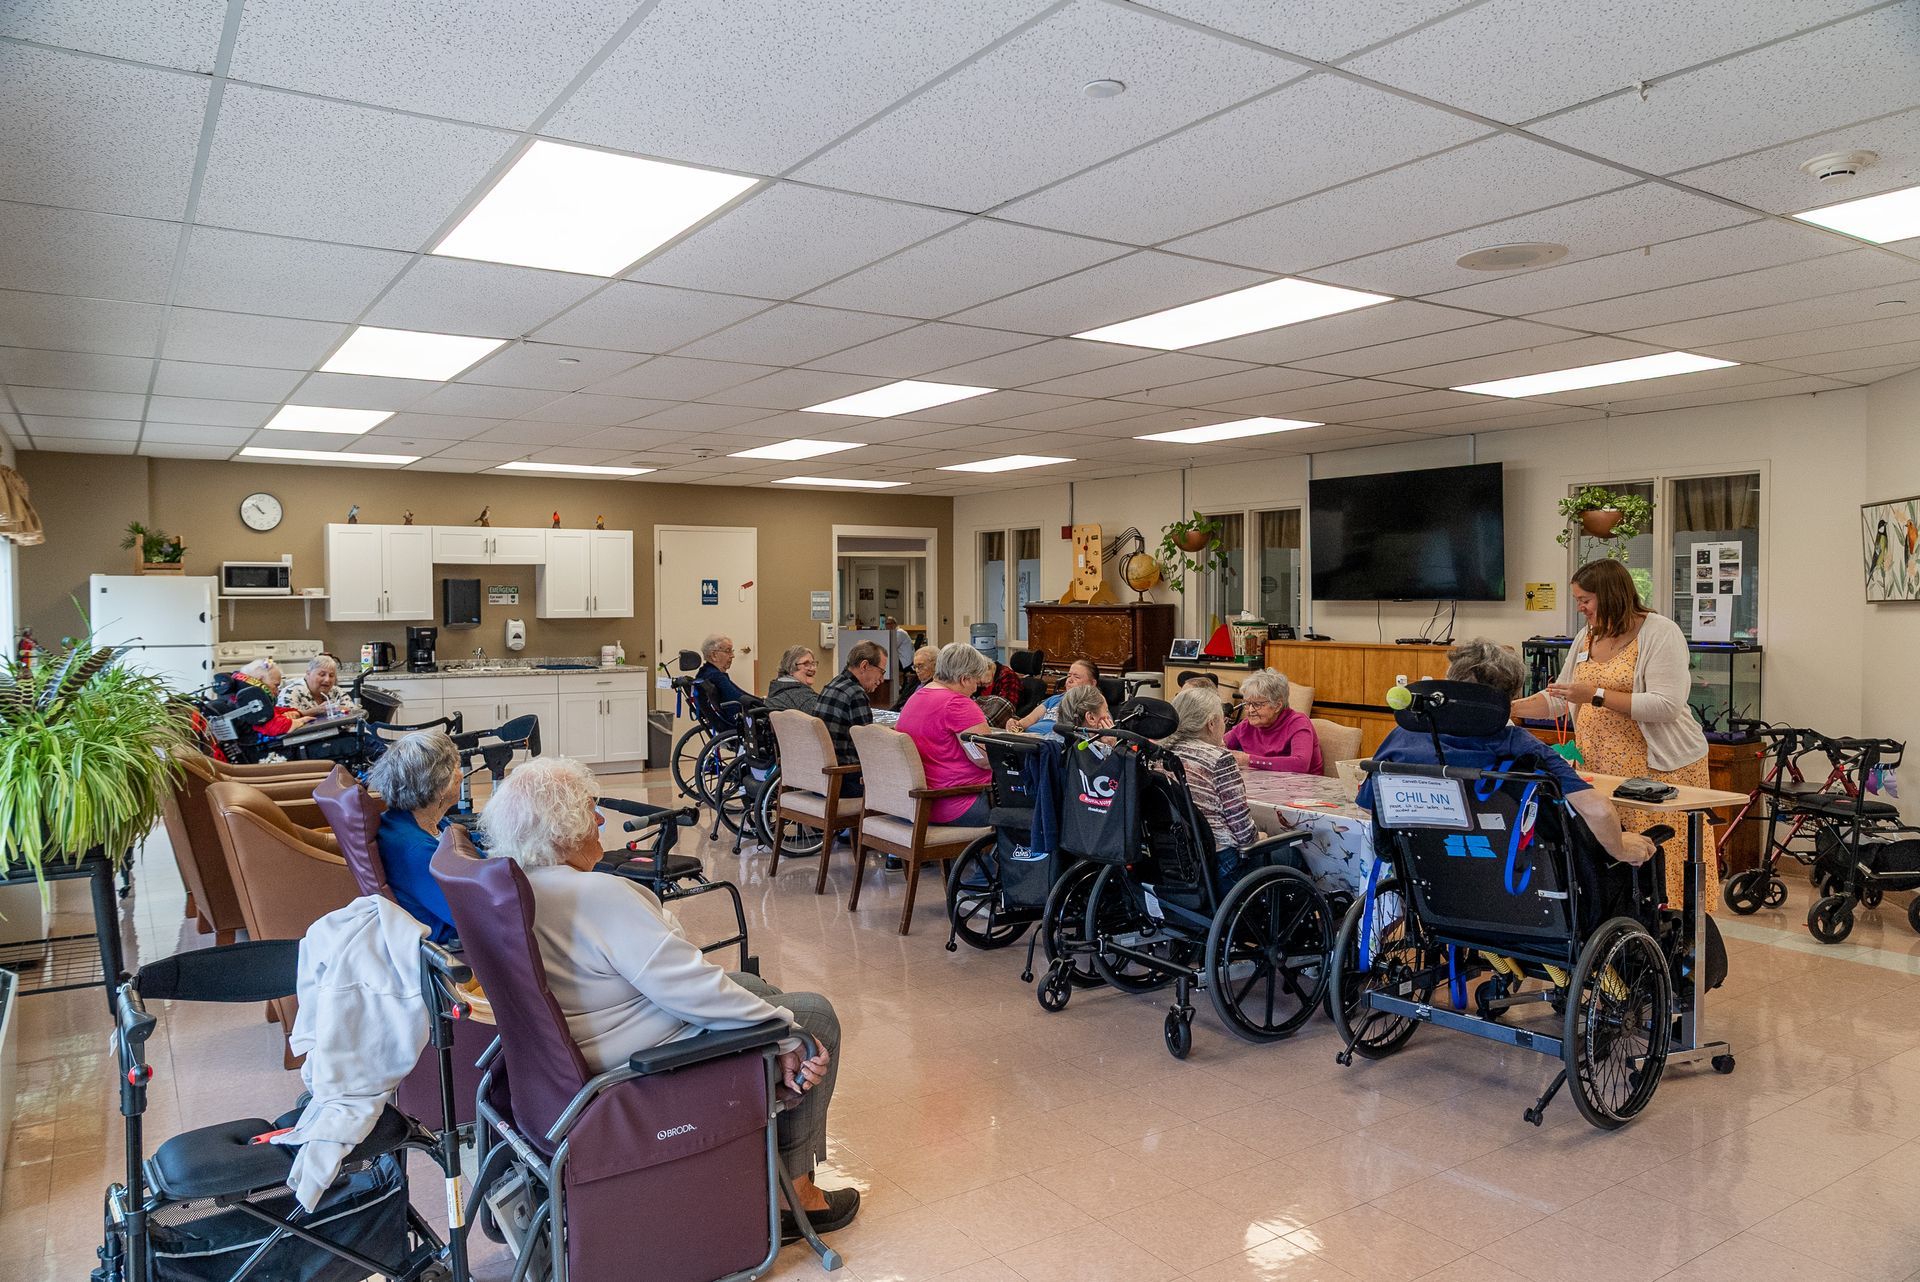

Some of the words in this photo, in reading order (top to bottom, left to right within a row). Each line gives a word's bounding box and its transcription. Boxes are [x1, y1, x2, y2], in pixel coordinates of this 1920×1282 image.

[1396, 792, 1427, 803] CHIL
[1430, 793, 1450, 804] NN
[667, 1123, 695, 1138] BRODA
